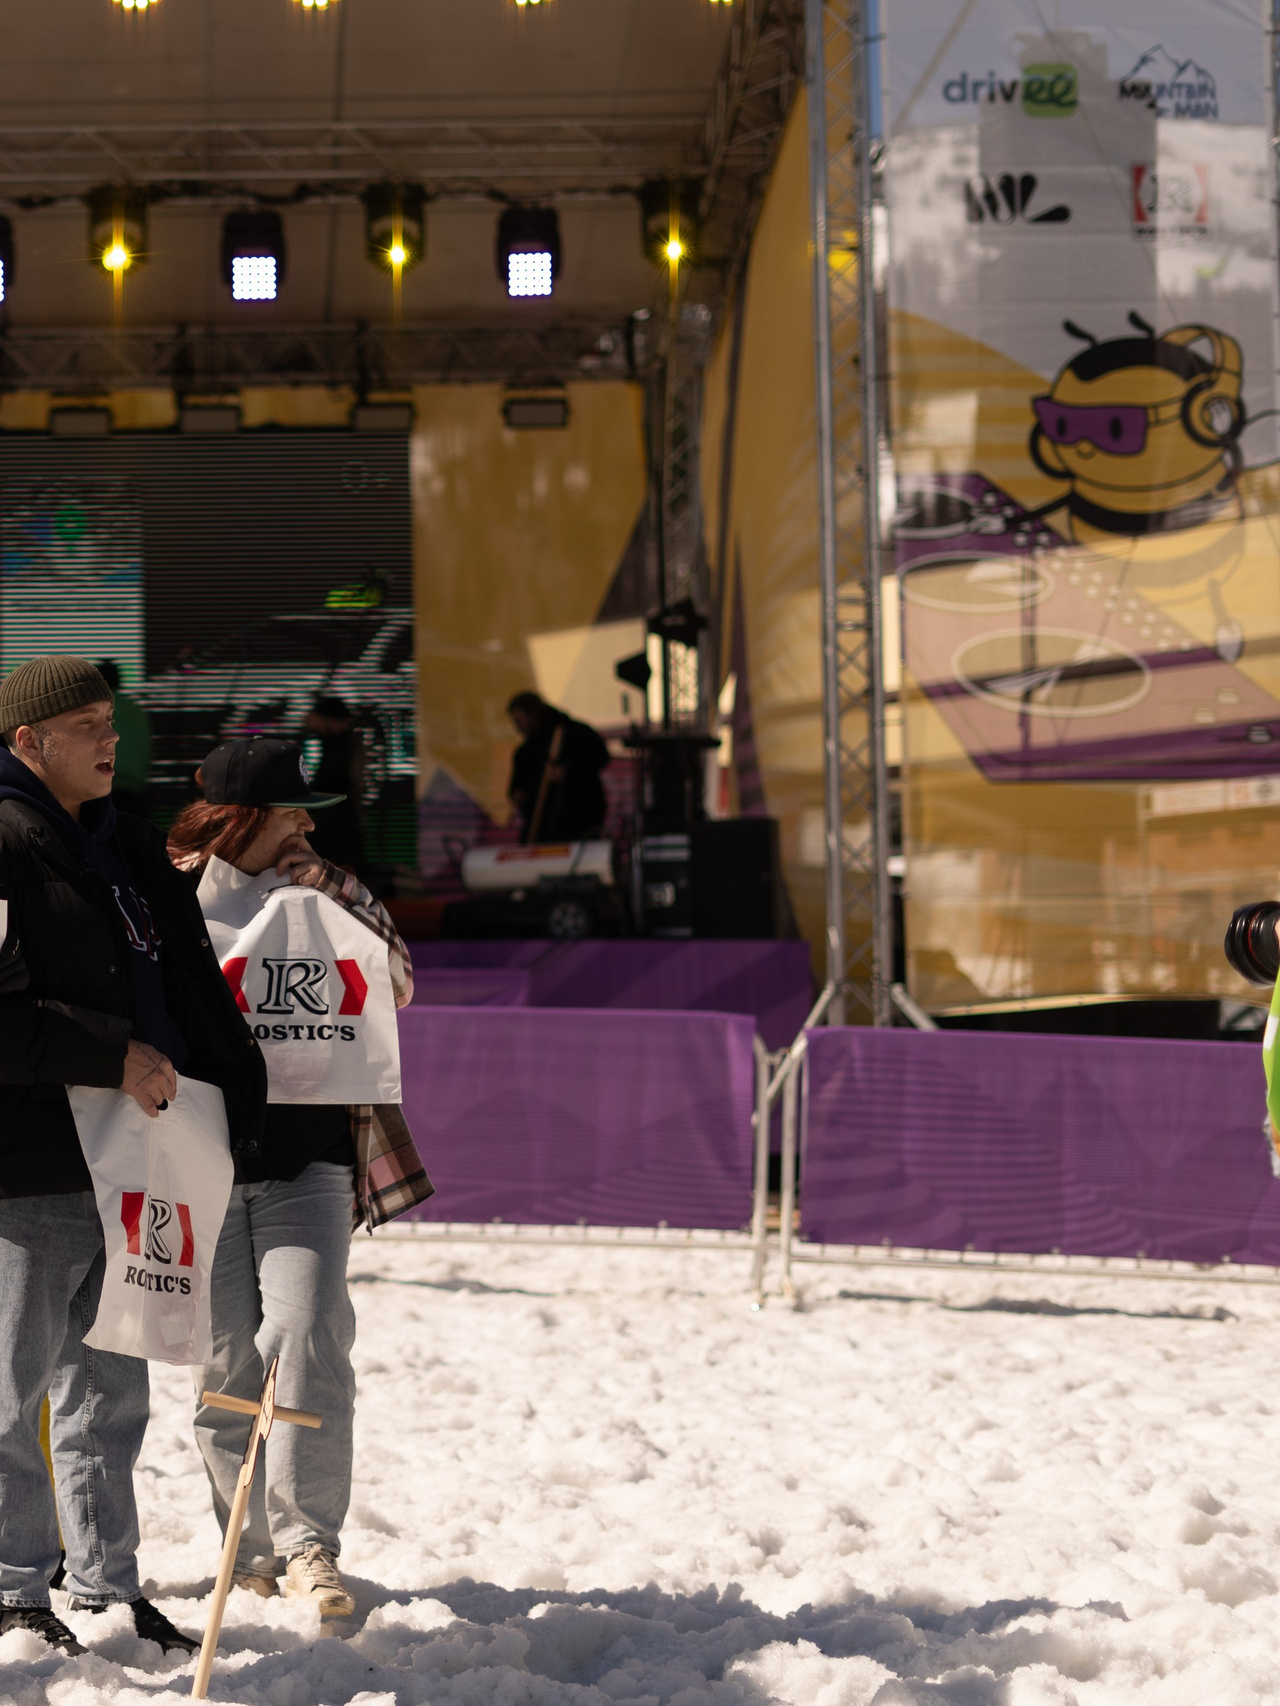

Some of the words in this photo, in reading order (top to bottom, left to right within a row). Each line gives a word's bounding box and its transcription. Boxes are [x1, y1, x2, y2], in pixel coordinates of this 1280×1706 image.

[943, 71, 1079, 108] drivee
[257, 958, 330, 1015] R
[250, 1024, 355, 1041] OSTIC'S
[123, 1265, 192, 1295] ROTIC'S
